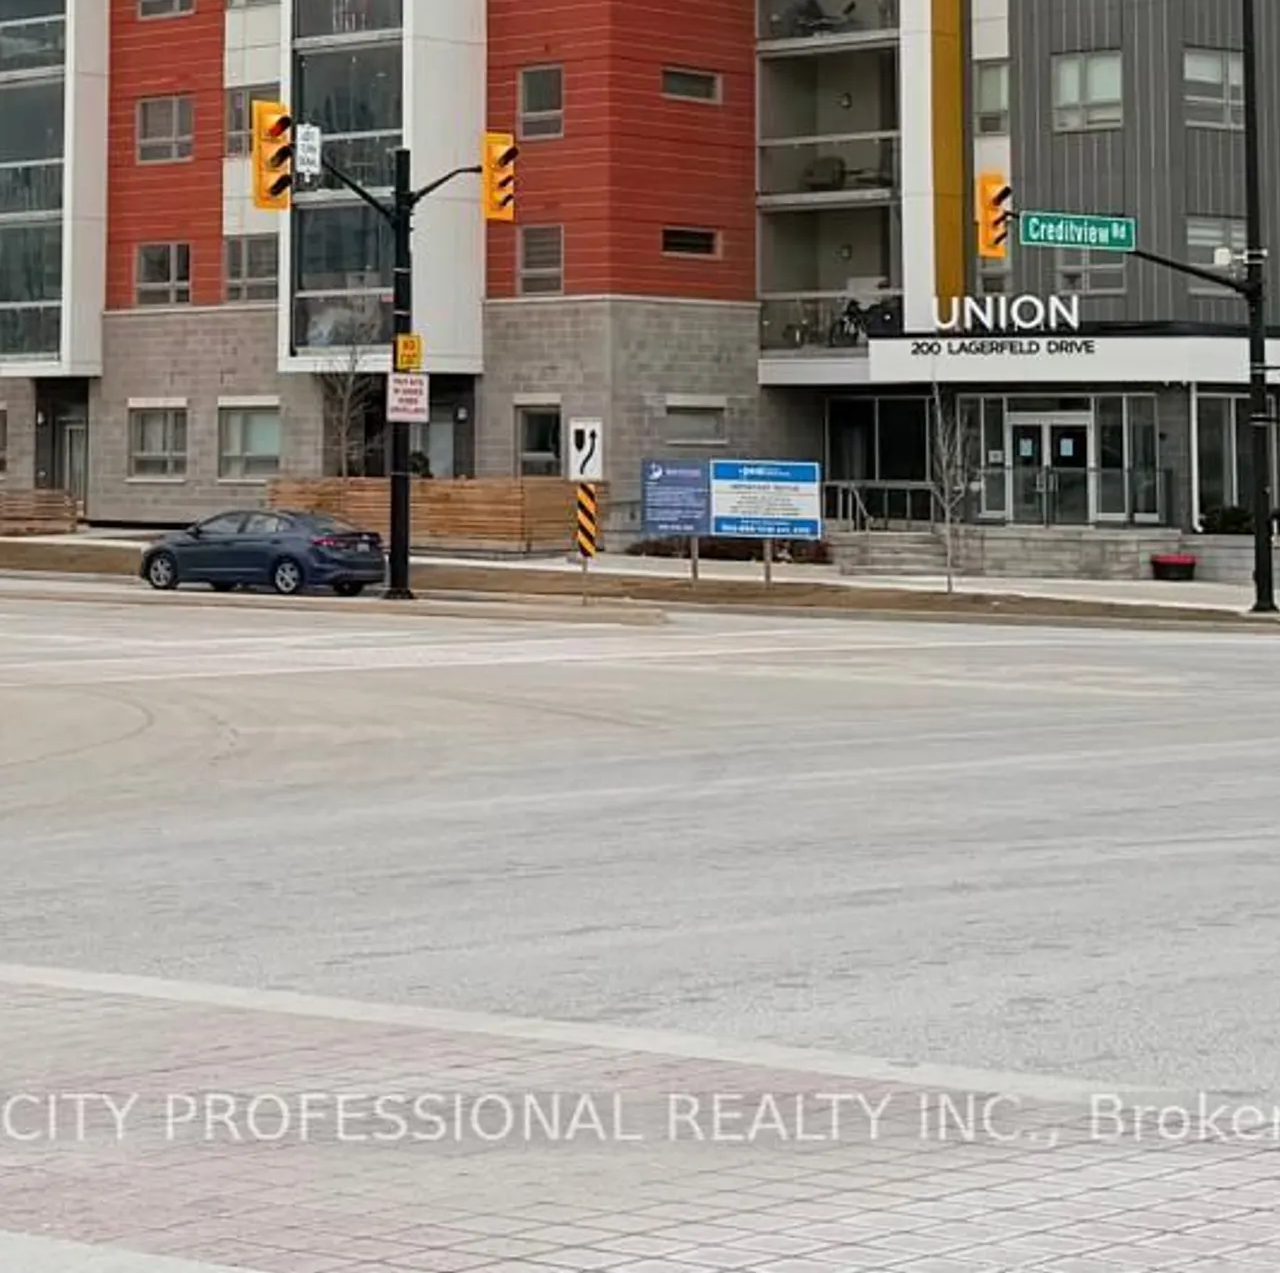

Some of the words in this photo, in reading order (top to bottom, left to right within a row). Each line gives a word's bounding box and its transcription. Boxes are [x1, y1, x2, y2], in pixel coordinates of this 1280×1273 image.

[1029, 217, 1109, 244] Creditview
[933, 294, 1079, 330] UNION
[911, 342, 941, 355] 200
[947, 341, 1040, 355] LAGERFELD
[1047, 340, 1095, 354] DRIVE
